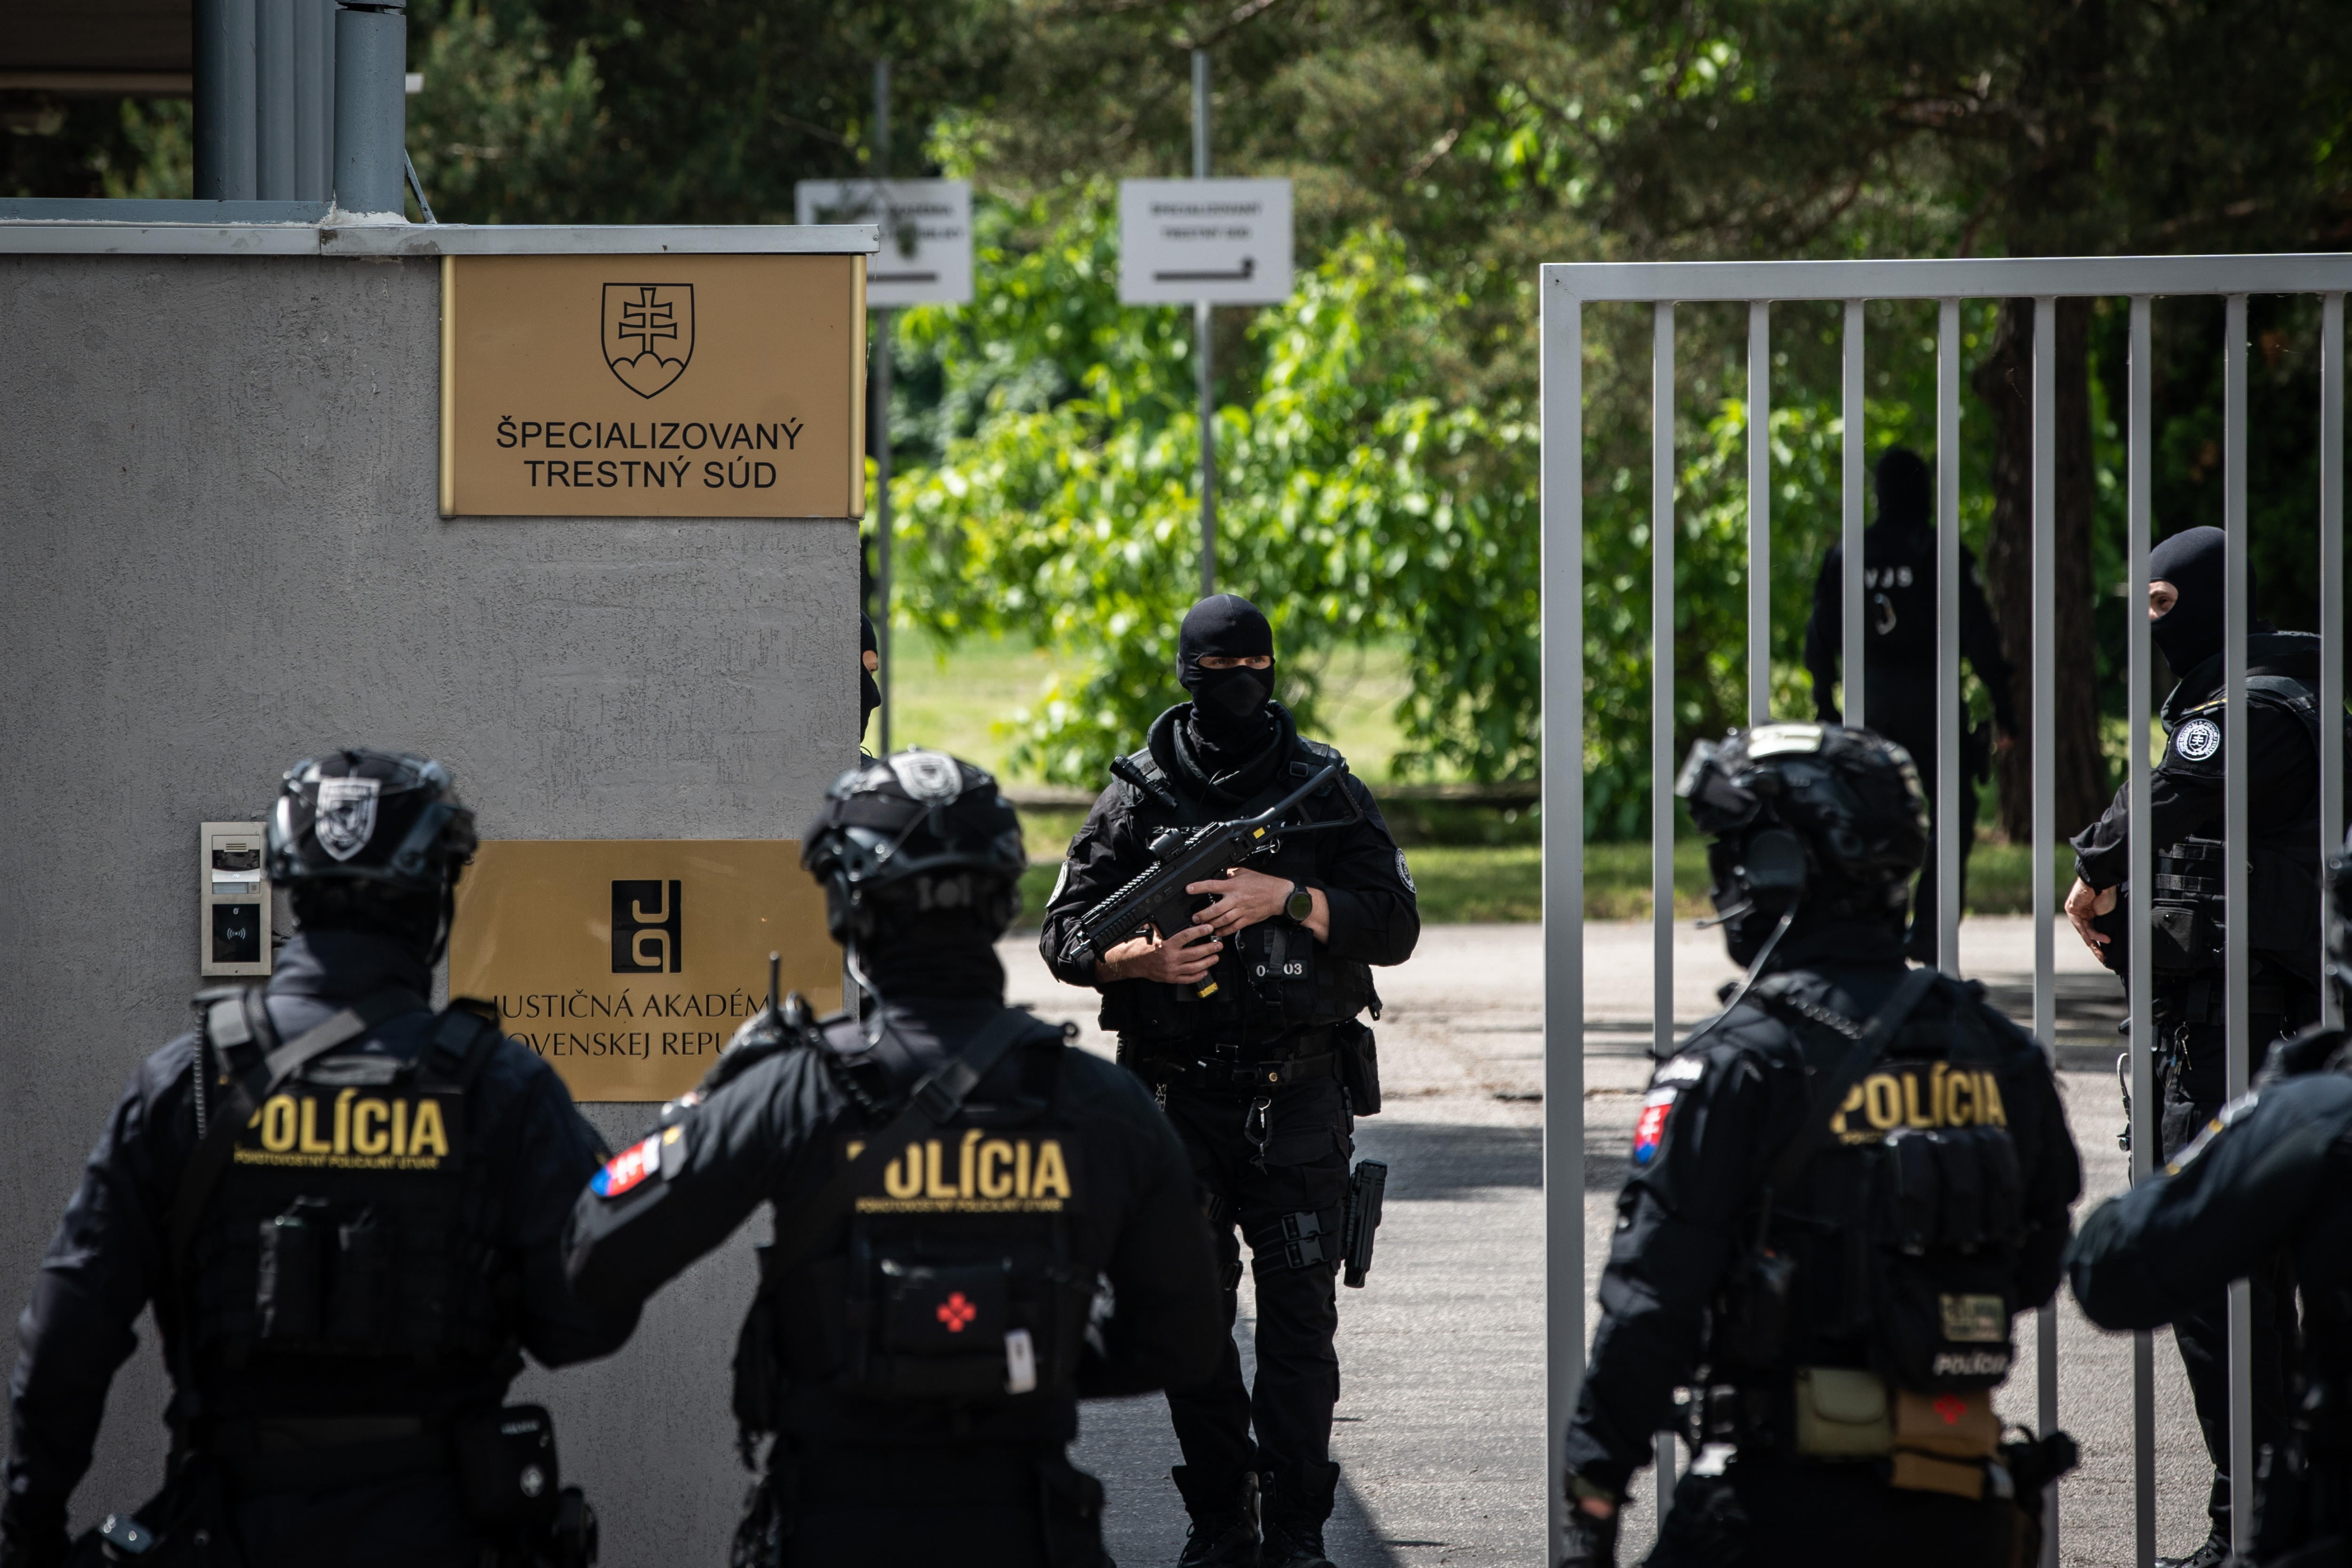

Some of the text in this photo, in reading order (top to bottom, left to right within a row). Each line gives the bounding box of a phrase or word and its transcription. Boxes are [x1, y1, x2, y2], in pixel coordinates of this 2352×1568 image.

[496, 415, 804, 449] ŠPECIALIZOVANÝ
[524, 455, 777, 488] TRESTNÝ SÚD
[1152, 826, 1202, 834] ZJS
[1256, 963, 1303, 977] 003
[643, 988, 769, 1018] AKADÉM
[508, 1033, 649, 1060] OVENSKEJ
[247, 1087, 449, 1157] OLÍCIA
[846, 1128, 1072, 1199] OLÍCIA
